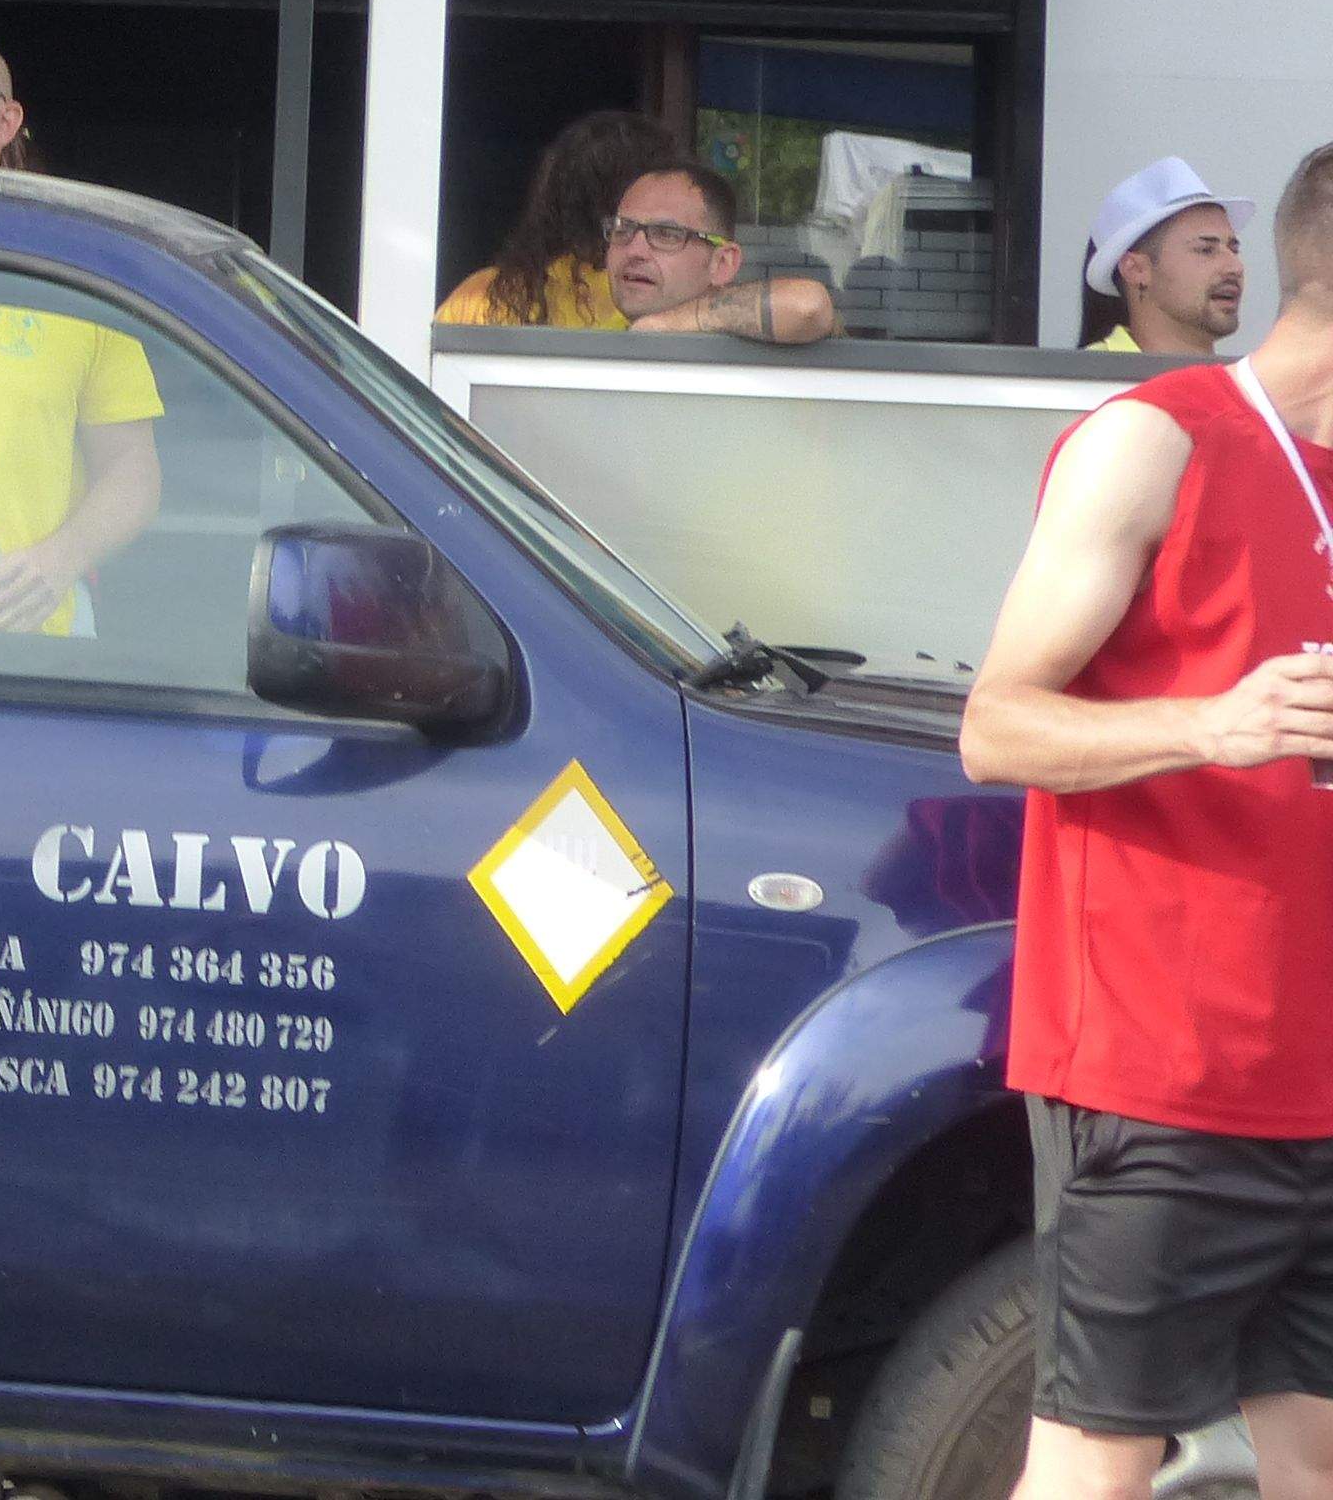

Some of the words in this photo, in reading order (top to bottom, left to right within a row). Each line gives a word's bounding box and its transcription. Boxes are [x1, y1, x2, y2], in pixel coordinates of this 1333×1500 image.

[32, 824, 367, 920] CALVO
[80, 940, 156, 980] 974
[169, 946, 245, 986] 364
[258, 952, 337, 991] 356
[137, 1004, 197, 1045] 974
[205, 1010, 267, 1049] 480
[275, 1014, 334, 1053] 729
[91, 1062, 165, 1103] 974
[176, 1068, 248, 1109] 242
[259, 1074, 333, 1115] 807
